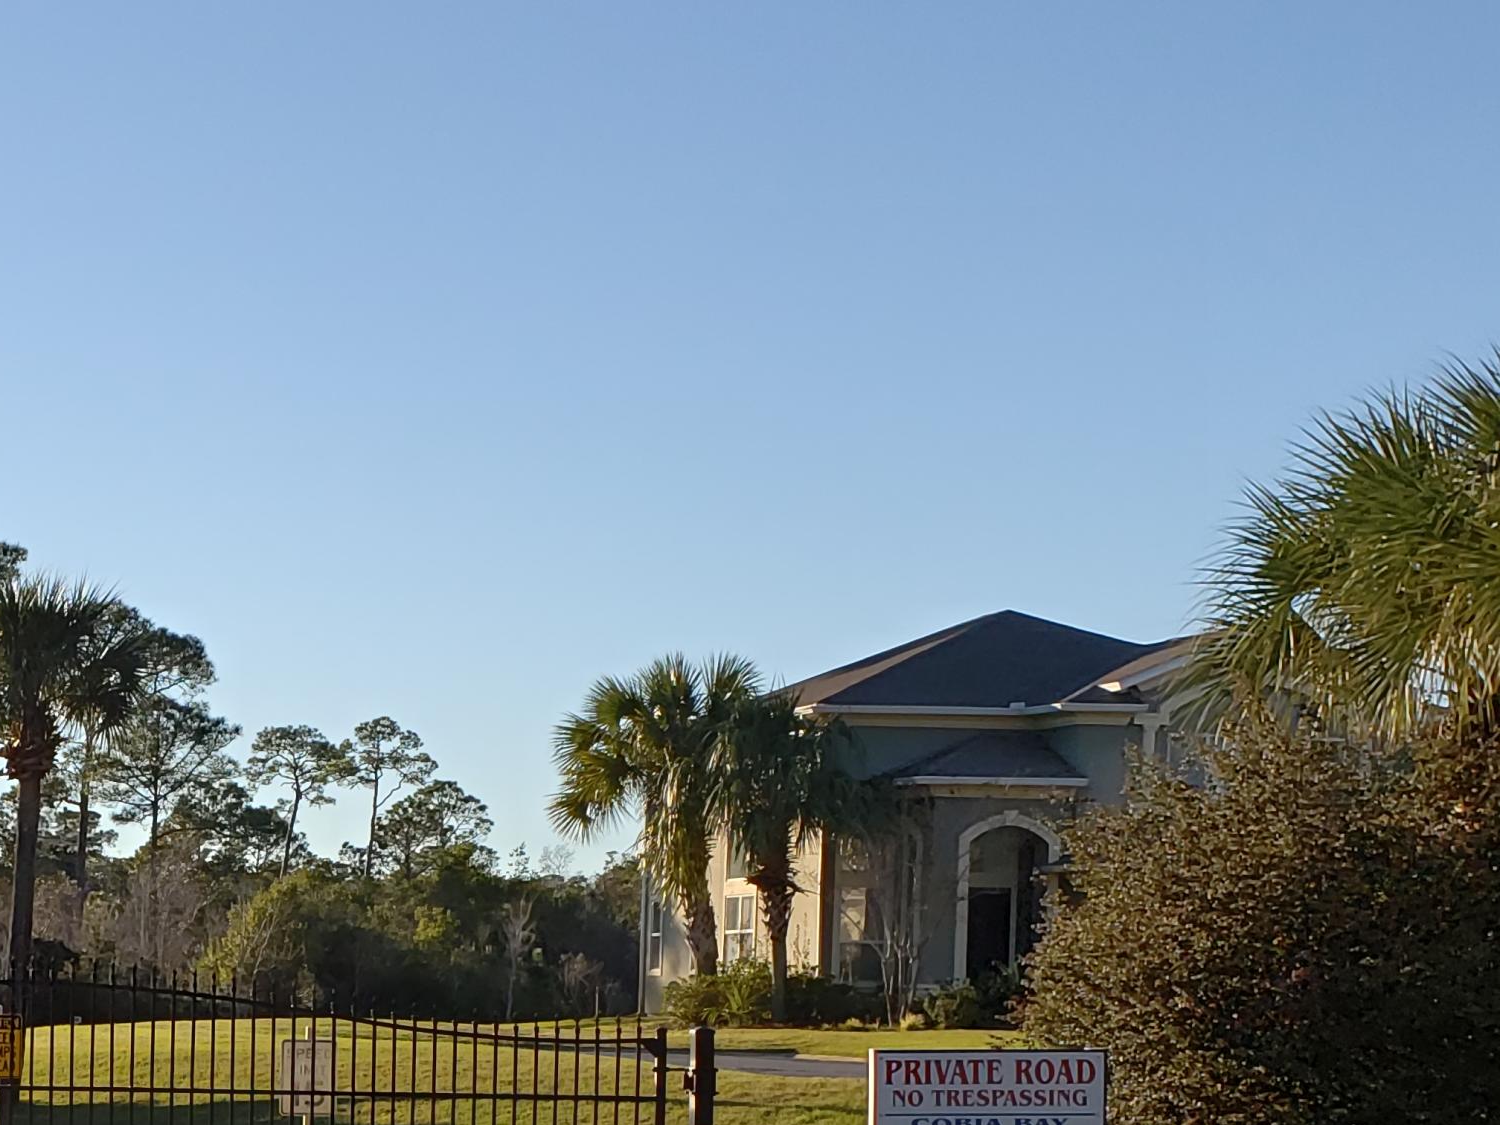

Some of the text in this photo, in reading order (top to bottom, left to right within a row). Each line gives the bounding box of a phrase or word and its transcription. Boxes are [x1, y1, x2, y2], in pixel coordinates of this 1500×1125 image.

[885, 1059, 1096, 1085] PRIVATE ROAD
[892, 1089, 1088, 1107] NO TRESPASSING
